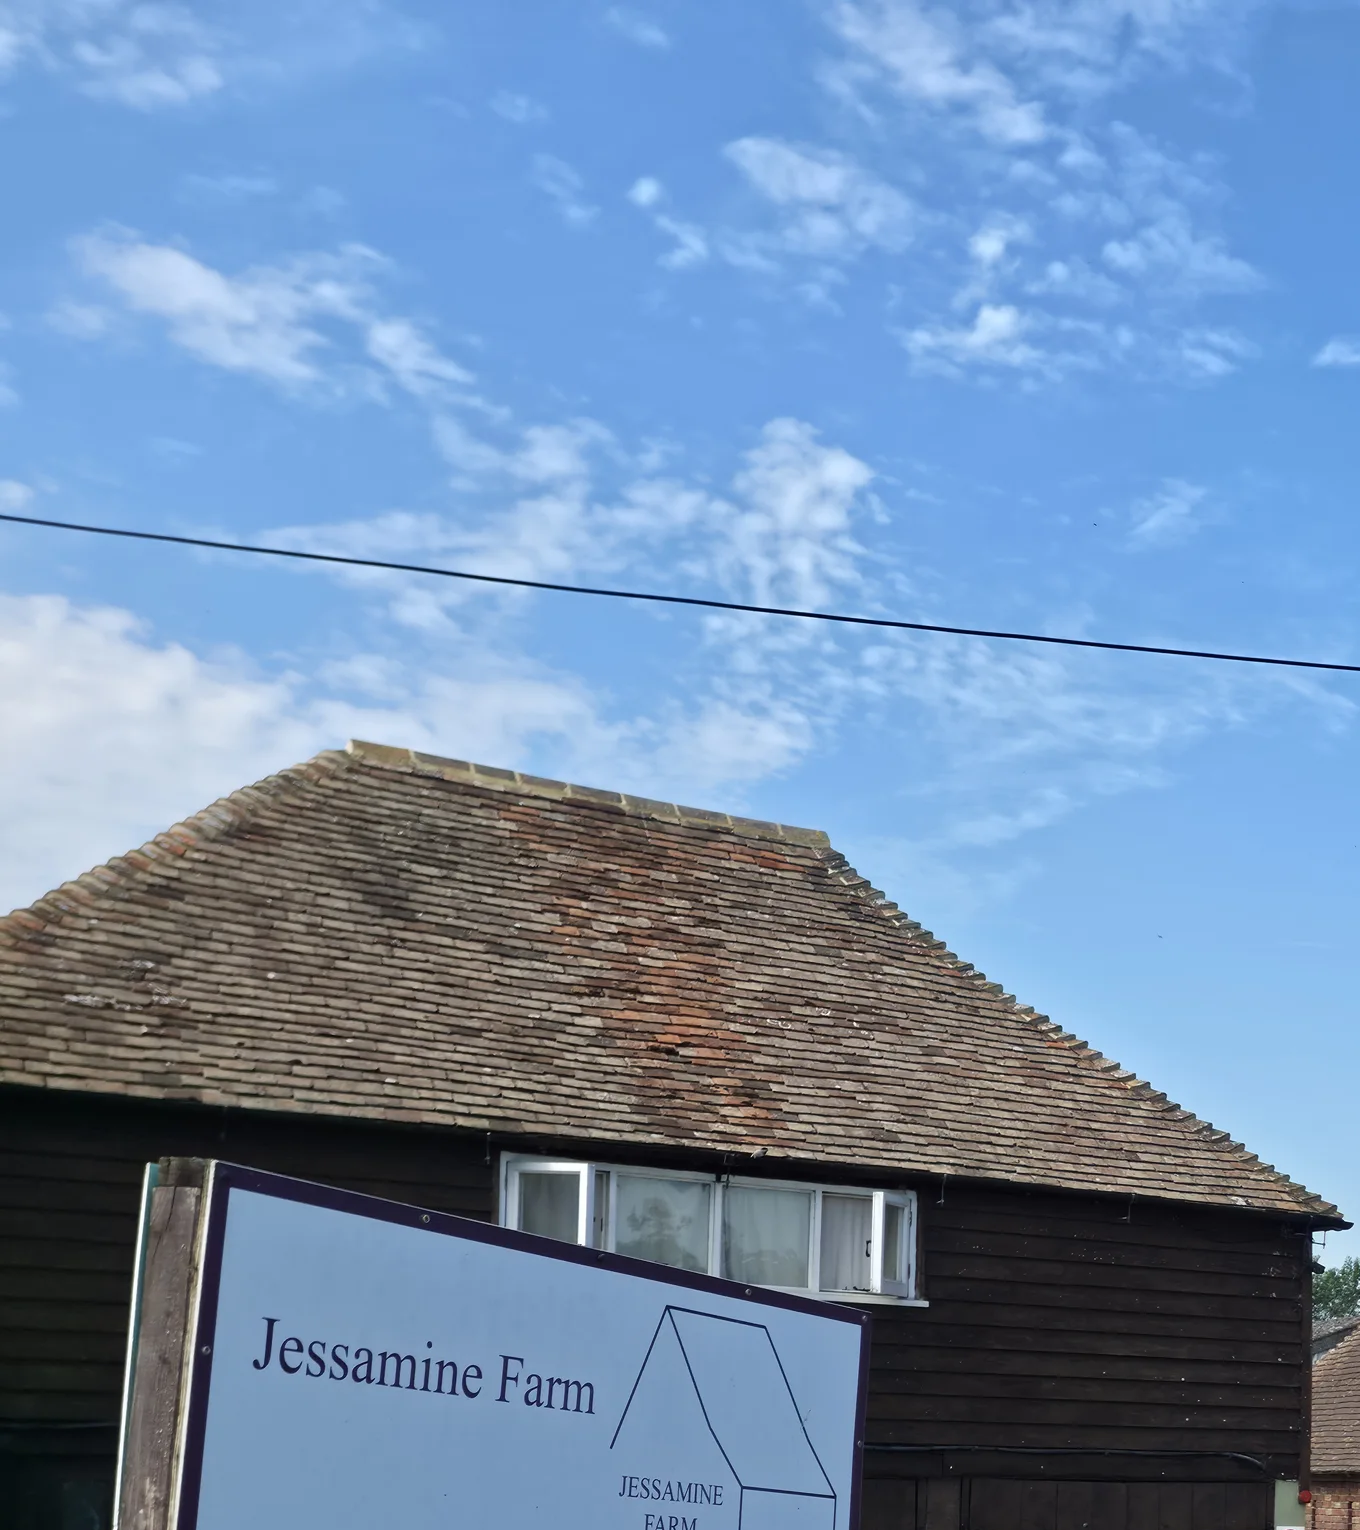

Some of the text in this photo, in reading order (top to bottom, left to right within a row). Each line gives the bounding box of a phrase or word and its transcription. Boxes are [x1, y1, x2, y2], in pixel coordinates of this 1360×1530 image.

[252, 1316, 596, 1415] Jessamine Farm
[618, 1475, 724, 1506] JESSAMINE
